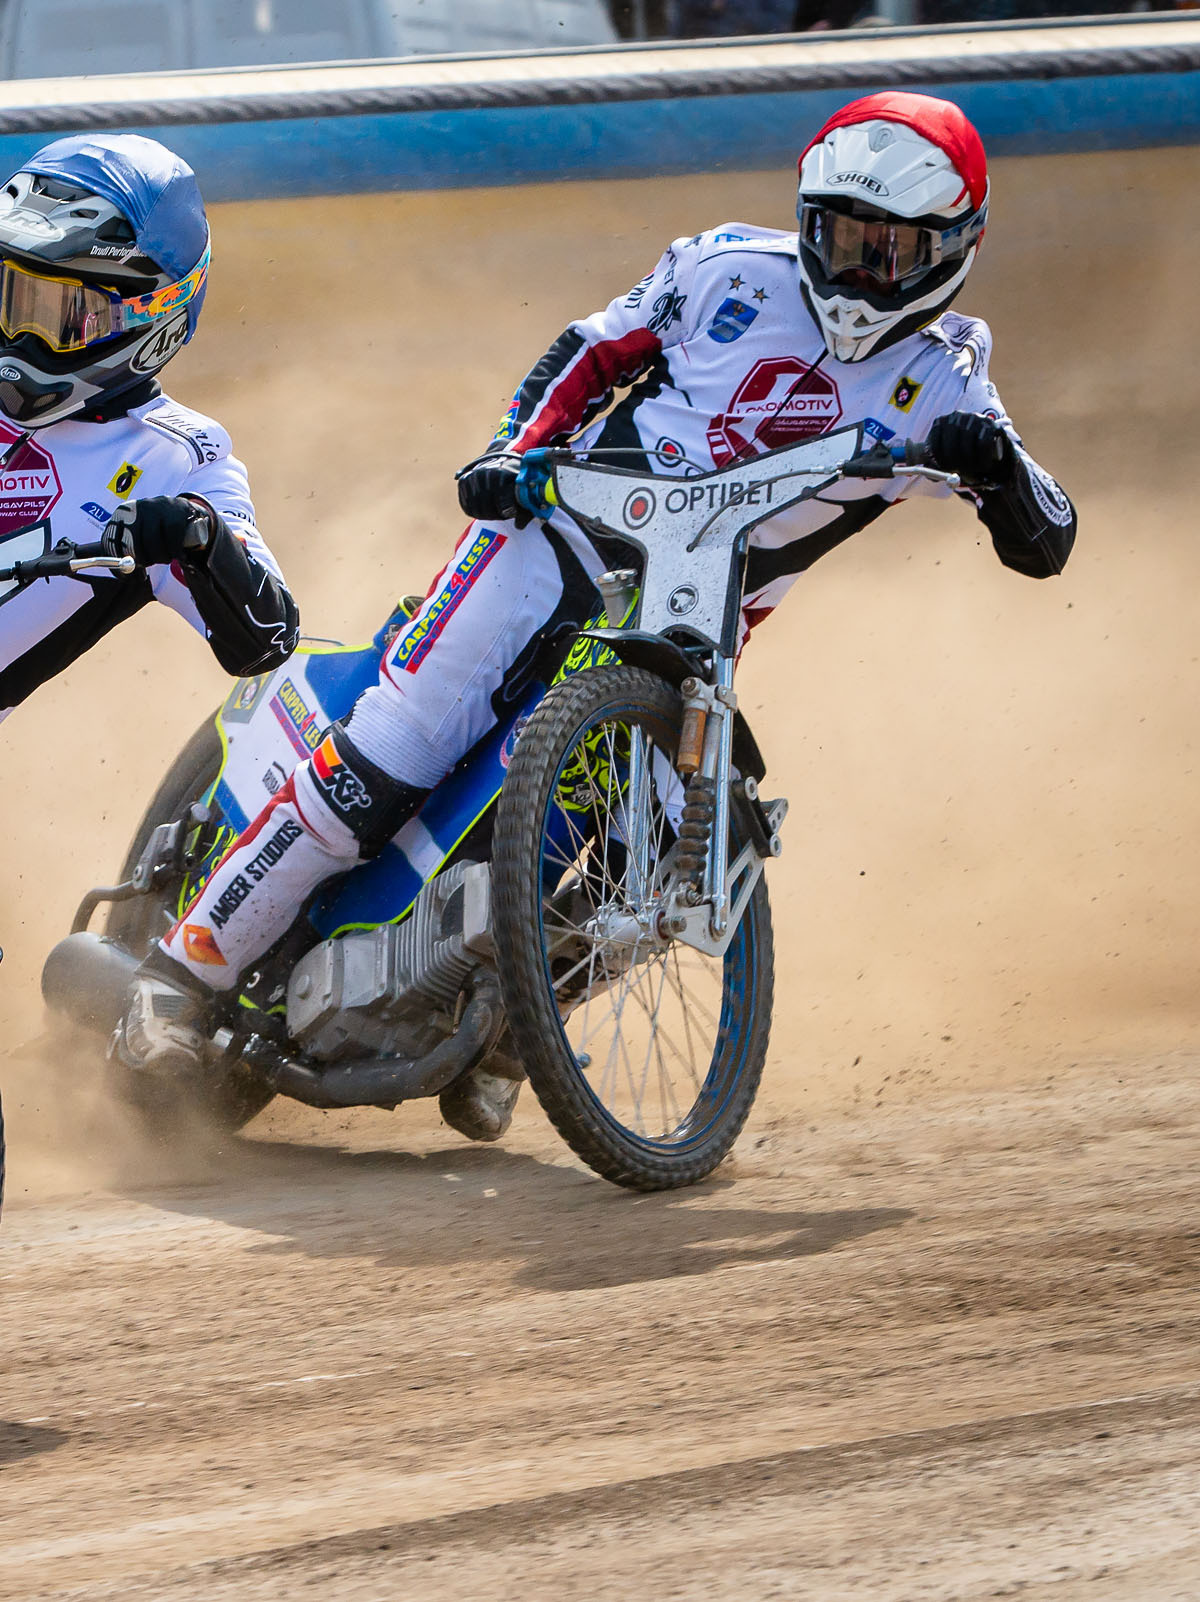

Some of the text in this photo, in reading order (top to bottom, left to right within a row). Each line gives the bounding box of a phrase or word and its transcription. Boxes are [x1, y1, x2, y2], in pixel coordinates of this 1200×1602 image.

[836, 173, 882, 193] SHOEI
[152, 320, 188, 357] Ara
[19, 509, 39, 518] CLUB
[665, 480, 778, 513] OPTIBET
[398, 535, 491, 661] CARPETS 4 LESS
[279, 681, 309, 724] CARPETS
[209, 873, 255, 929] AMBER
[245, 819, 305, 882] STUDIOS
